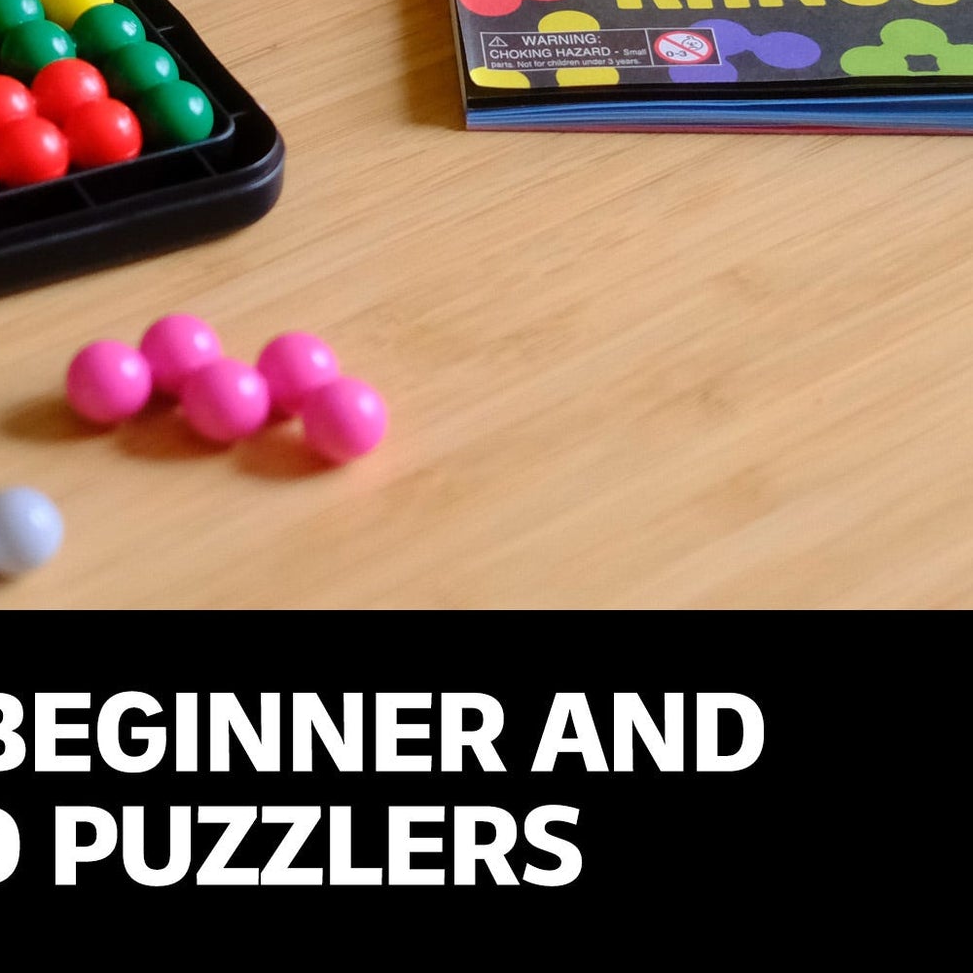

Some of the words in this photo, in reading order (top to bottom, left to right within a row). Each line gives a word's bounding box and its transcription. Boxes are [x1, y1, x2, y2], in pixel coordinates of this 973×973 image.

[521, 33, 601, 46] WARNING:
[489, 48, 552, 59] CHOKING
[555, 47, 611, 57] HAZARD
[623, 48, 647, 56] Small
[547, 59, 580, 67] children
[582, 58, 606, 66] under
